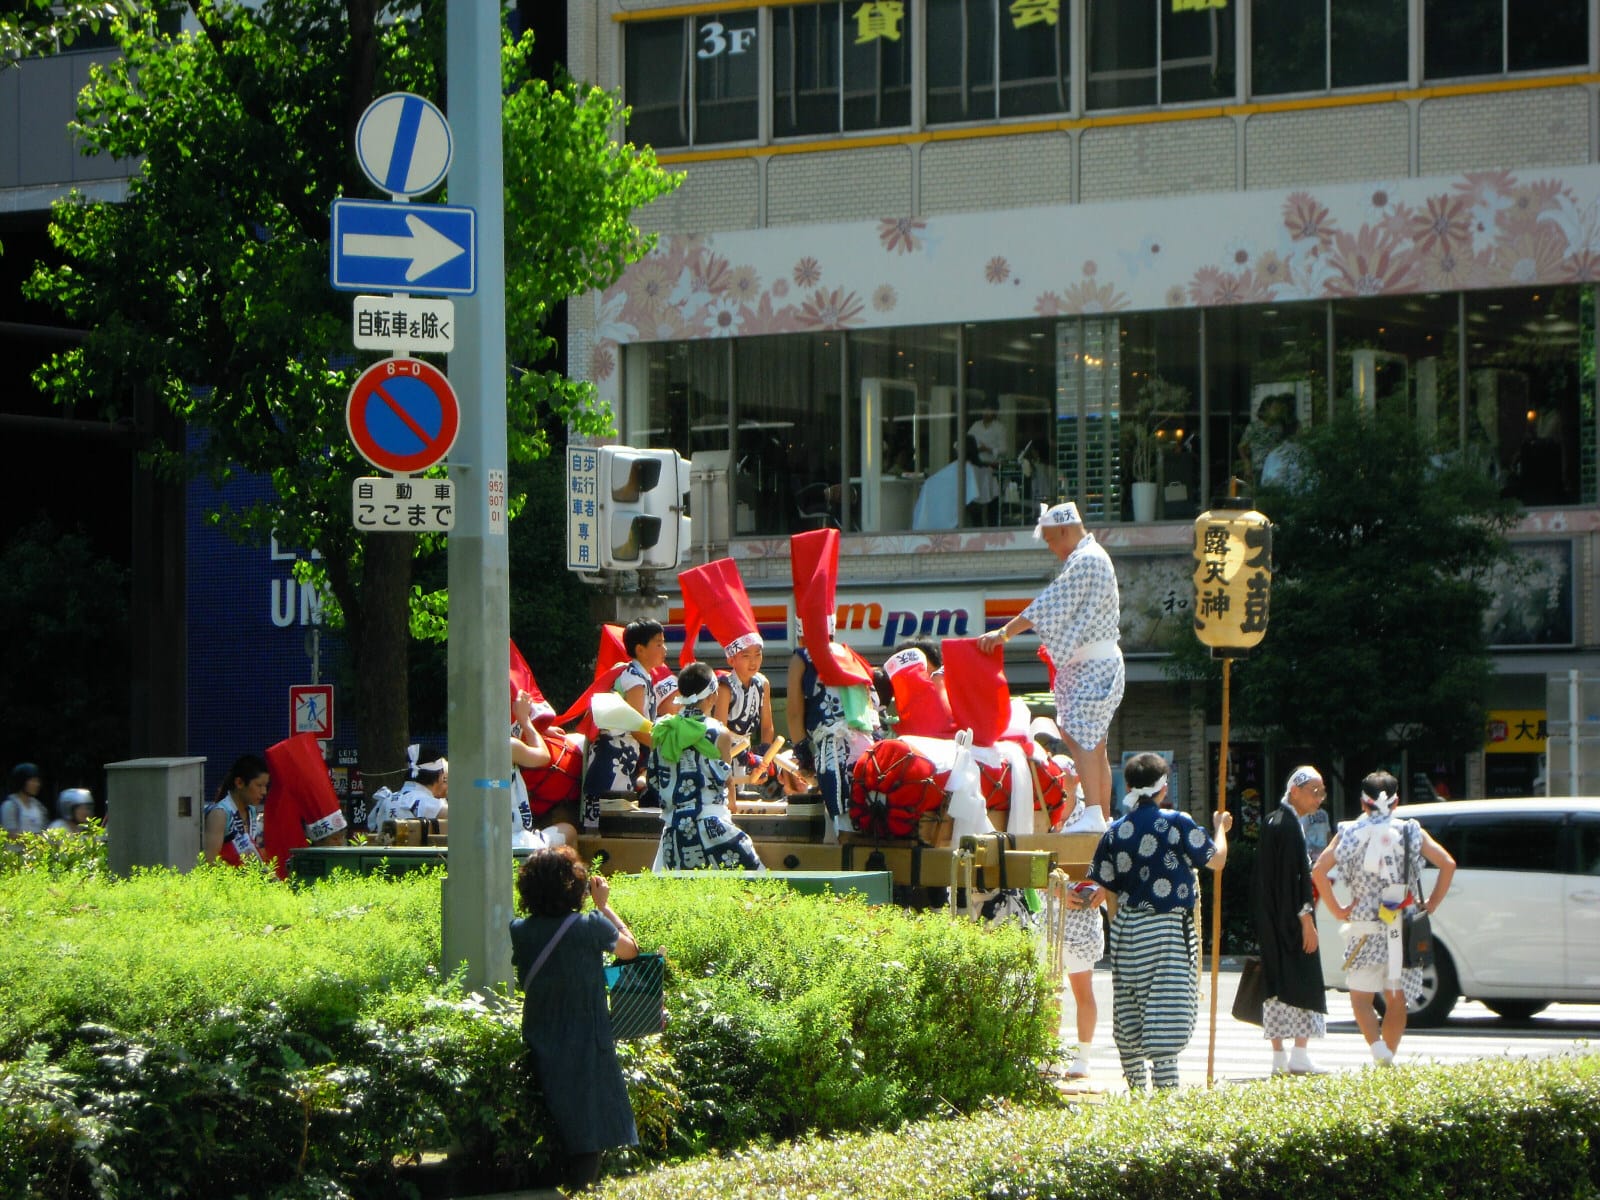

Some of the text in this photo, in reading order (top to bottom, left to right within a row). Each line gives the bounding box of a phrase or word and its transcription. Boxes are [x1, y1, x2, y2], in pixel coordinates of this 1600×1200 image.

[697, 22, 756, 59] 3F
[358, 309, 450, 340] 自転車を除く
[358, 482, 451, 500] 自動車
[571, 454, 584, 516] 自転車
[583, 455, 595, 517] 歩行者
[358, 504, 452, 526] ここまで
[578, 522, 590, 563] 専用
[1202, 526, 1231, 620] 露天神
